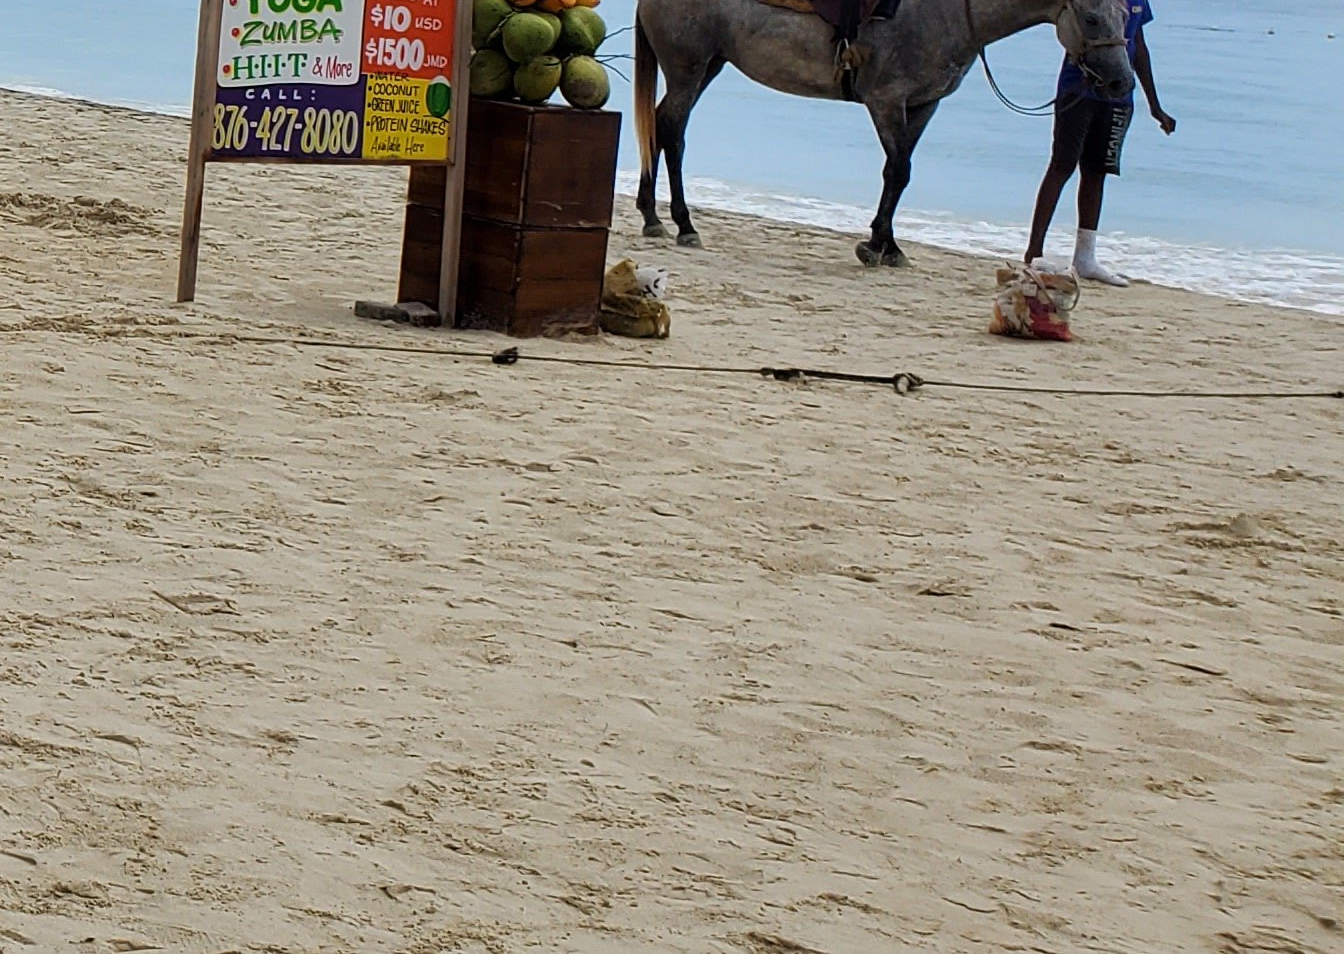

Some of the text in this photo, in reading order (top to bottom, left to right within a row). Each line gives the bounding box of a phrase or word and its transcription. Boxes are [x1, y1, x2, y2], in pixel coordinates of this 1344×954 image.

[371, 4, 411, 33] $10
[240, 18, 343, 47] ZUMBA
[312, 57, 322, 77] &
[326, 55, 352, 79] More
[365, 37, 447, 71] $1500 JMD
[374, 83, 420, 97] COCONUT
[371, 98, 420, 114] GREEN JUICE
[213, 103, 358, 154] 876-427-8080
[371, 118, 408, 132] PROTEIN
